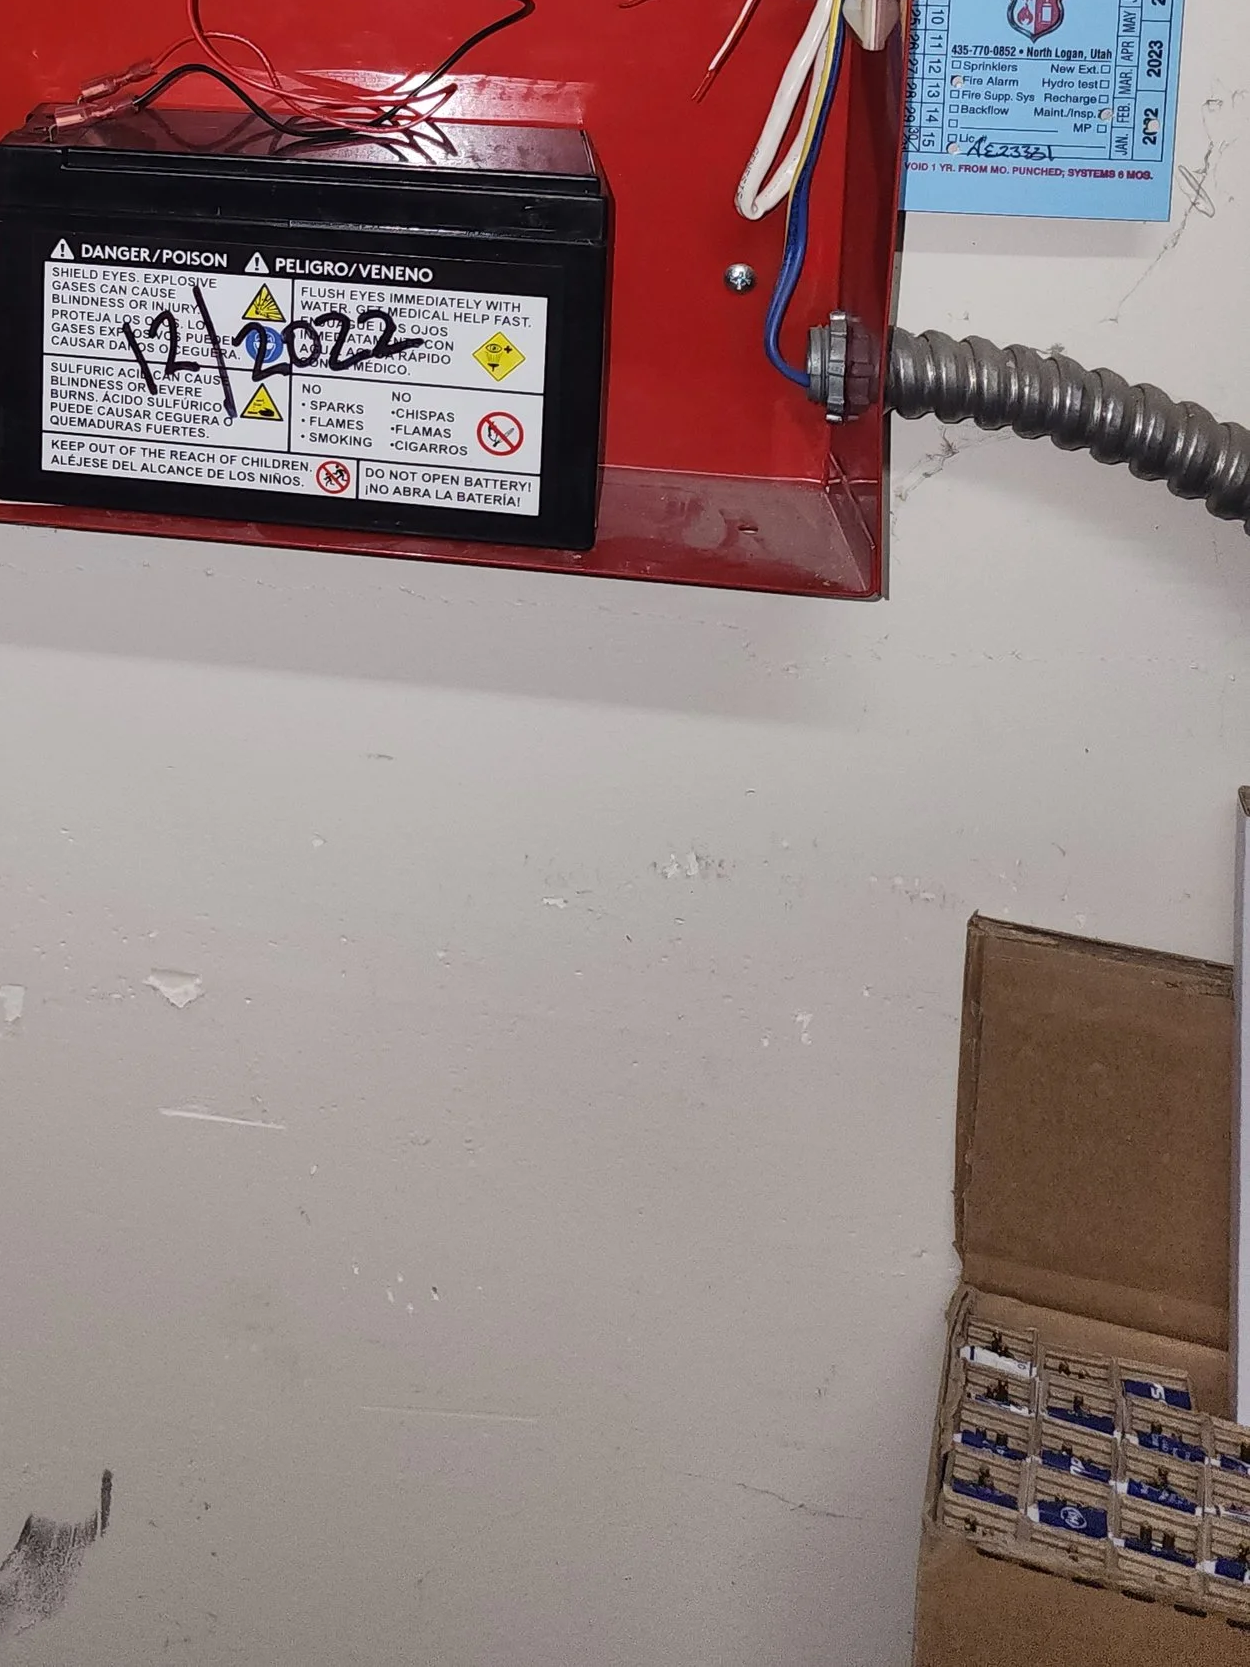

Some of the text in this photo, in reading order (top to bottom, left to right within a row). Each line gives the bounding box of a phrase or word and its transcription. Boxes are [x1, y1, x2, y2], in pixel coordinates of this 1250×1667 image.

[951, 44, 1113, 61] 435-770-0852 North Logan, Utah
[1147, 39, 1164, 78] 2023
[962, 60, 1018, 73] Sprinklers
[1050, 63, 1100, 75] New Ext.
[962, 75, 1019, 87] Fire Alarm
[1041, 77, 1099, 90] Hydro test
[961, 89, 1035, 104] Fire Supp. Sys
[1043, 92, 1098, 106] Recharge
[960, 104, 1010, 116] Backflow
[1033, 106, 1097, 121] Maint./Insp.
[1072, 122, 1092, 133] MP
[904, 159, 929, 173] VOID
[931, 163, 936, 172] 1
[939, 163, 956, 172] YR.
[958, 164, 988, 174] FROM
[989, 165, 1010, 175] MO.
[1012, 166, 1065, 179] PUNCHED;
[1067, 168, 1116, 179] SYSTEMS
[1126, 170, 1154, 181] MOS.
[81, 243, 228, 268] DANGER/POISON
[275, 257, 433, 283] PELIGRO/VENENO
[301, 286, 521, 313] FLUSH EYES IMMEDIATELY WITH
[386, 306, 531, 328] MEDICAL HELP FAST.
[122, 286, 425, 418] 12/2022
[302, 383, 322, 395] NO
[391, 391, 412, 403] NO
[309, 400, 364, 415] SPARKS
[395, 407, 455, 423] CHISPAS
[309, 416, 364, 431] FLAMES
[395, 424, 452, 439] FLAMAS
[308, 431, 373, 448] SMOKING
[51, 439, 313, 473] KEEP OUT OF THE REACH OF CHILDREN.
[394, 440, 468, 456] CIGARROS
[50, 453, 304, 487] ALÉJESE DEL ALCANCE DE LOS NIÑOS.
[365, 467, 532, 493] DO NOT OPEN BATTERY!
[365, 483, 521, 508] ¡NO ABRA LA BATERÍA!
